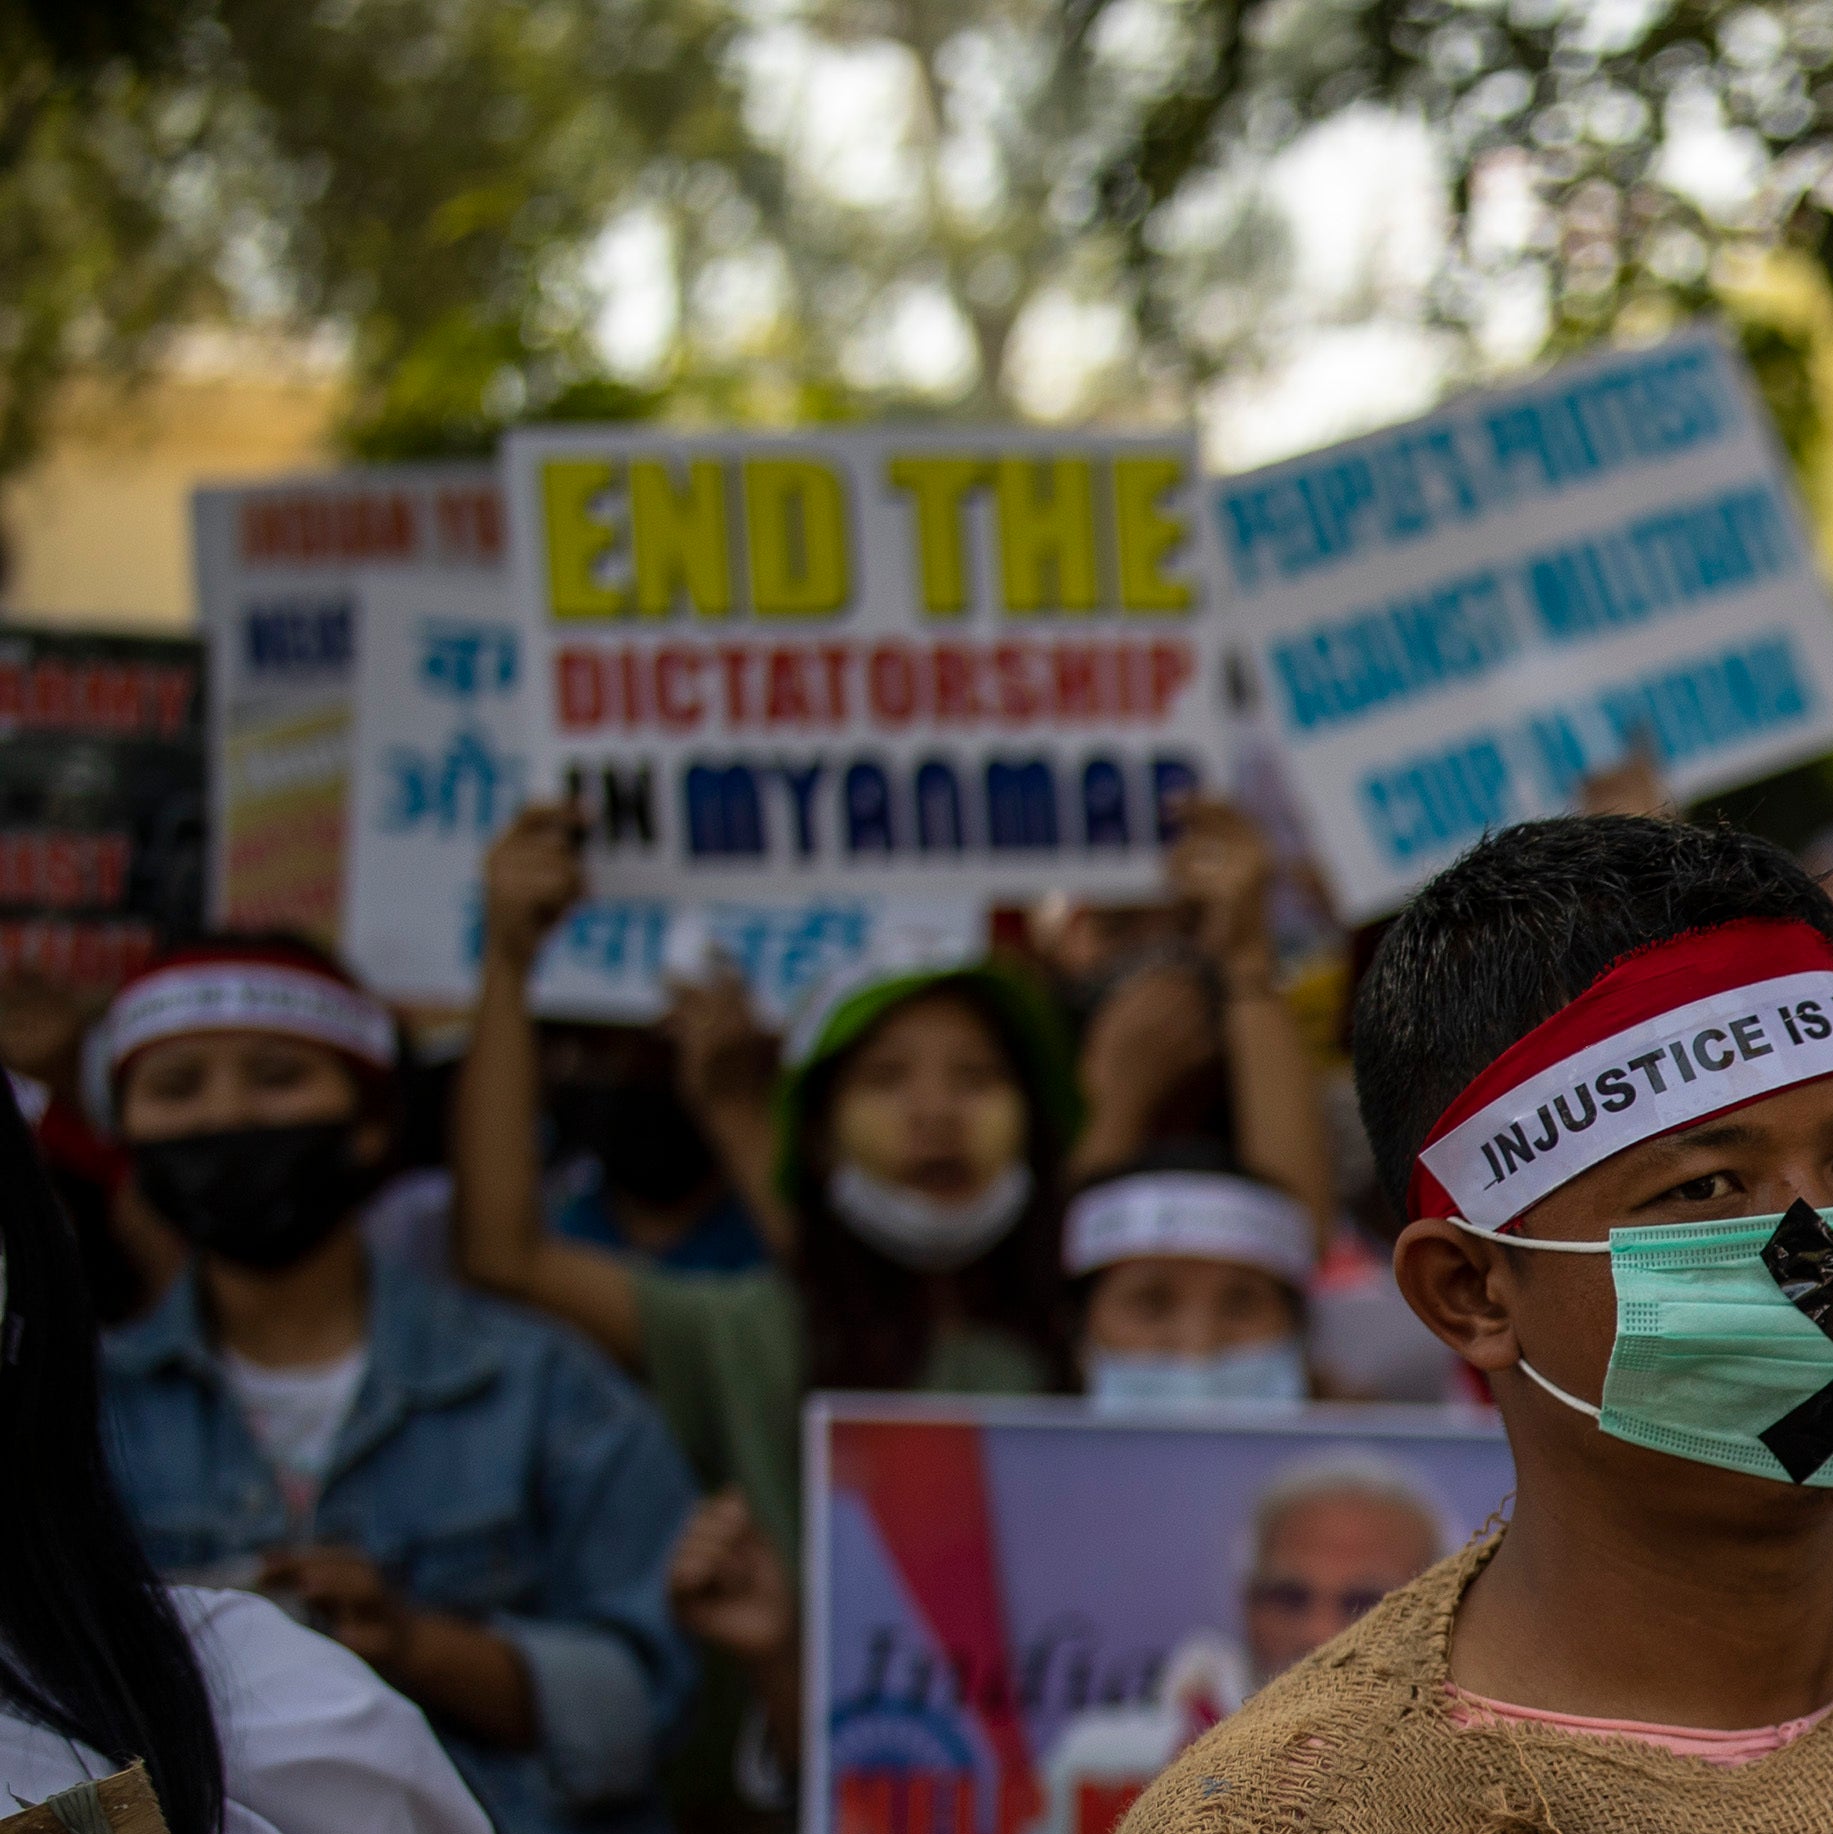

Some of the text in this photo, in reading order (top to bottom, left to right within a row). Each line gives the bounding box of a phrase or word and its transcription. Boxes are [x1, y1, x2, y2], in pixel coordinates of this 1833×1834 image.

[541, 456, 1192, 621] END THE
[556, 640, 1192, 732] DICTATORSHIP
[1480, 1014, 1774, 1191] INJUSTICE
[1776, 998, 1833, 1047] IS
